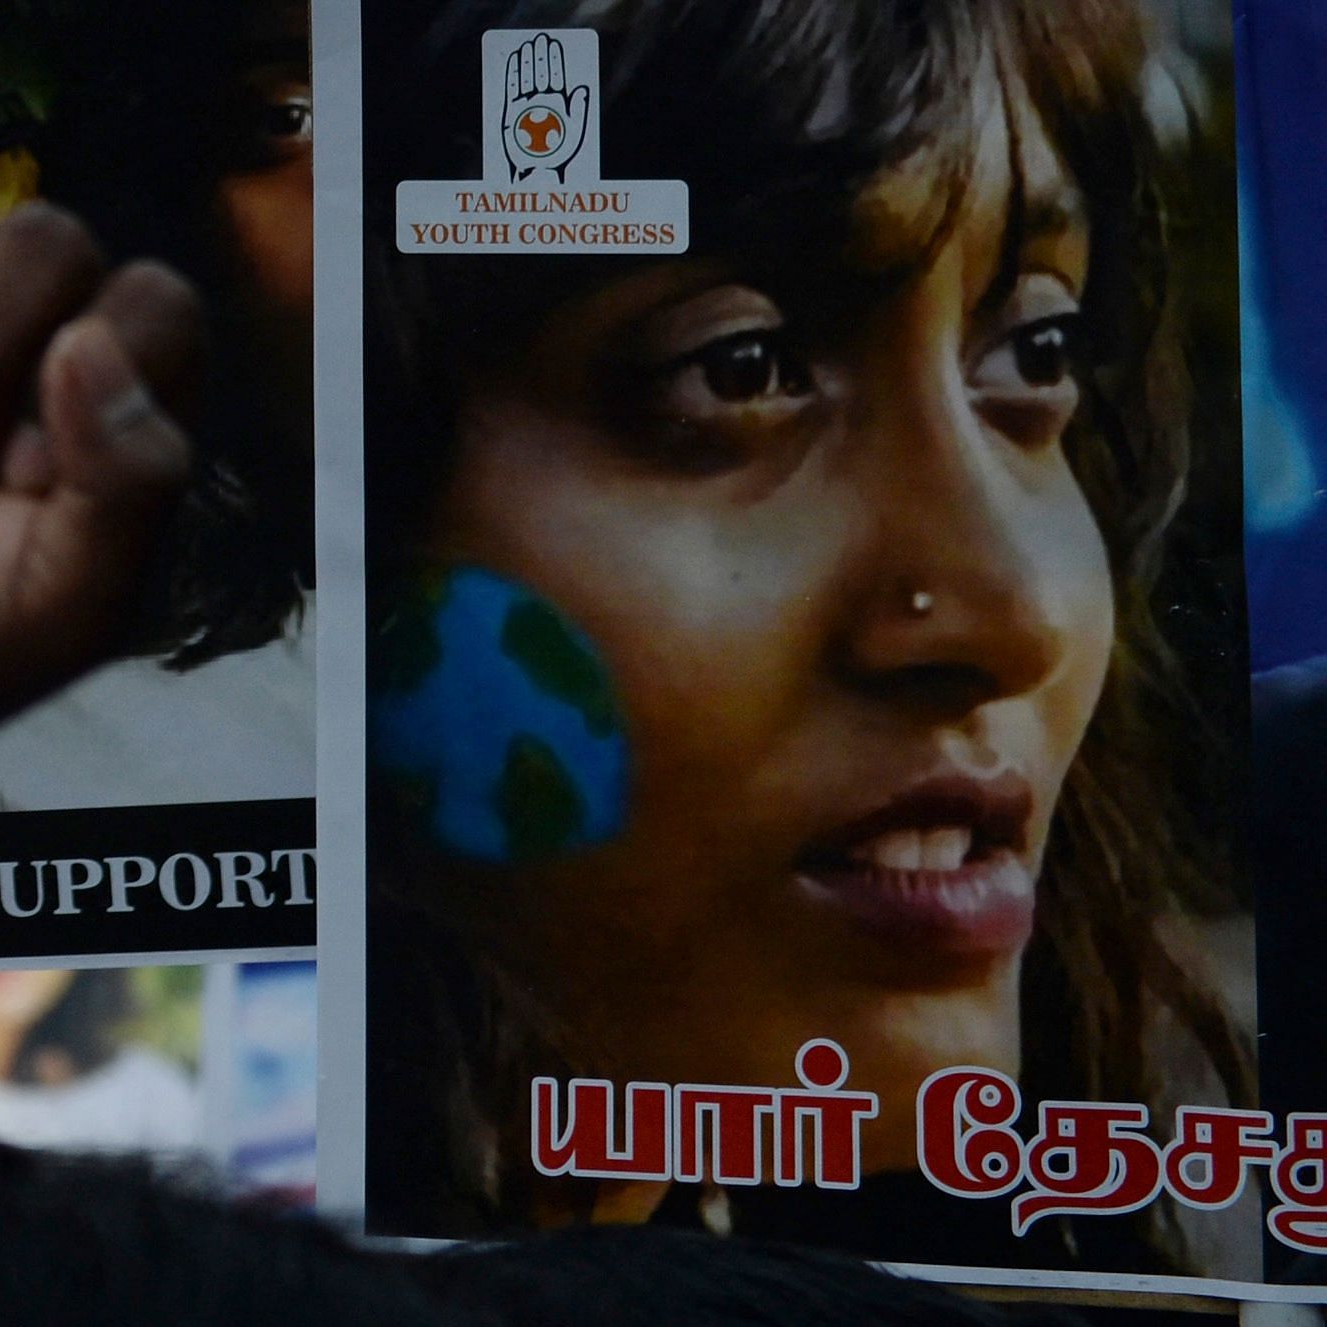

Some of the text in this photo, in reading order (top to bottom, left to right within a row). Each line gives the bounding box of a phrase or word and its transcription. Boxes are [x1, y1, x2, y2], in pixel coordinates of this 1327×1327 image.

[455, 191, 631, 214] TAMILNADU
[410, 222, 676, 246] YOUTH CONGRESS
[531, 1038, 879, 1191] யார்
